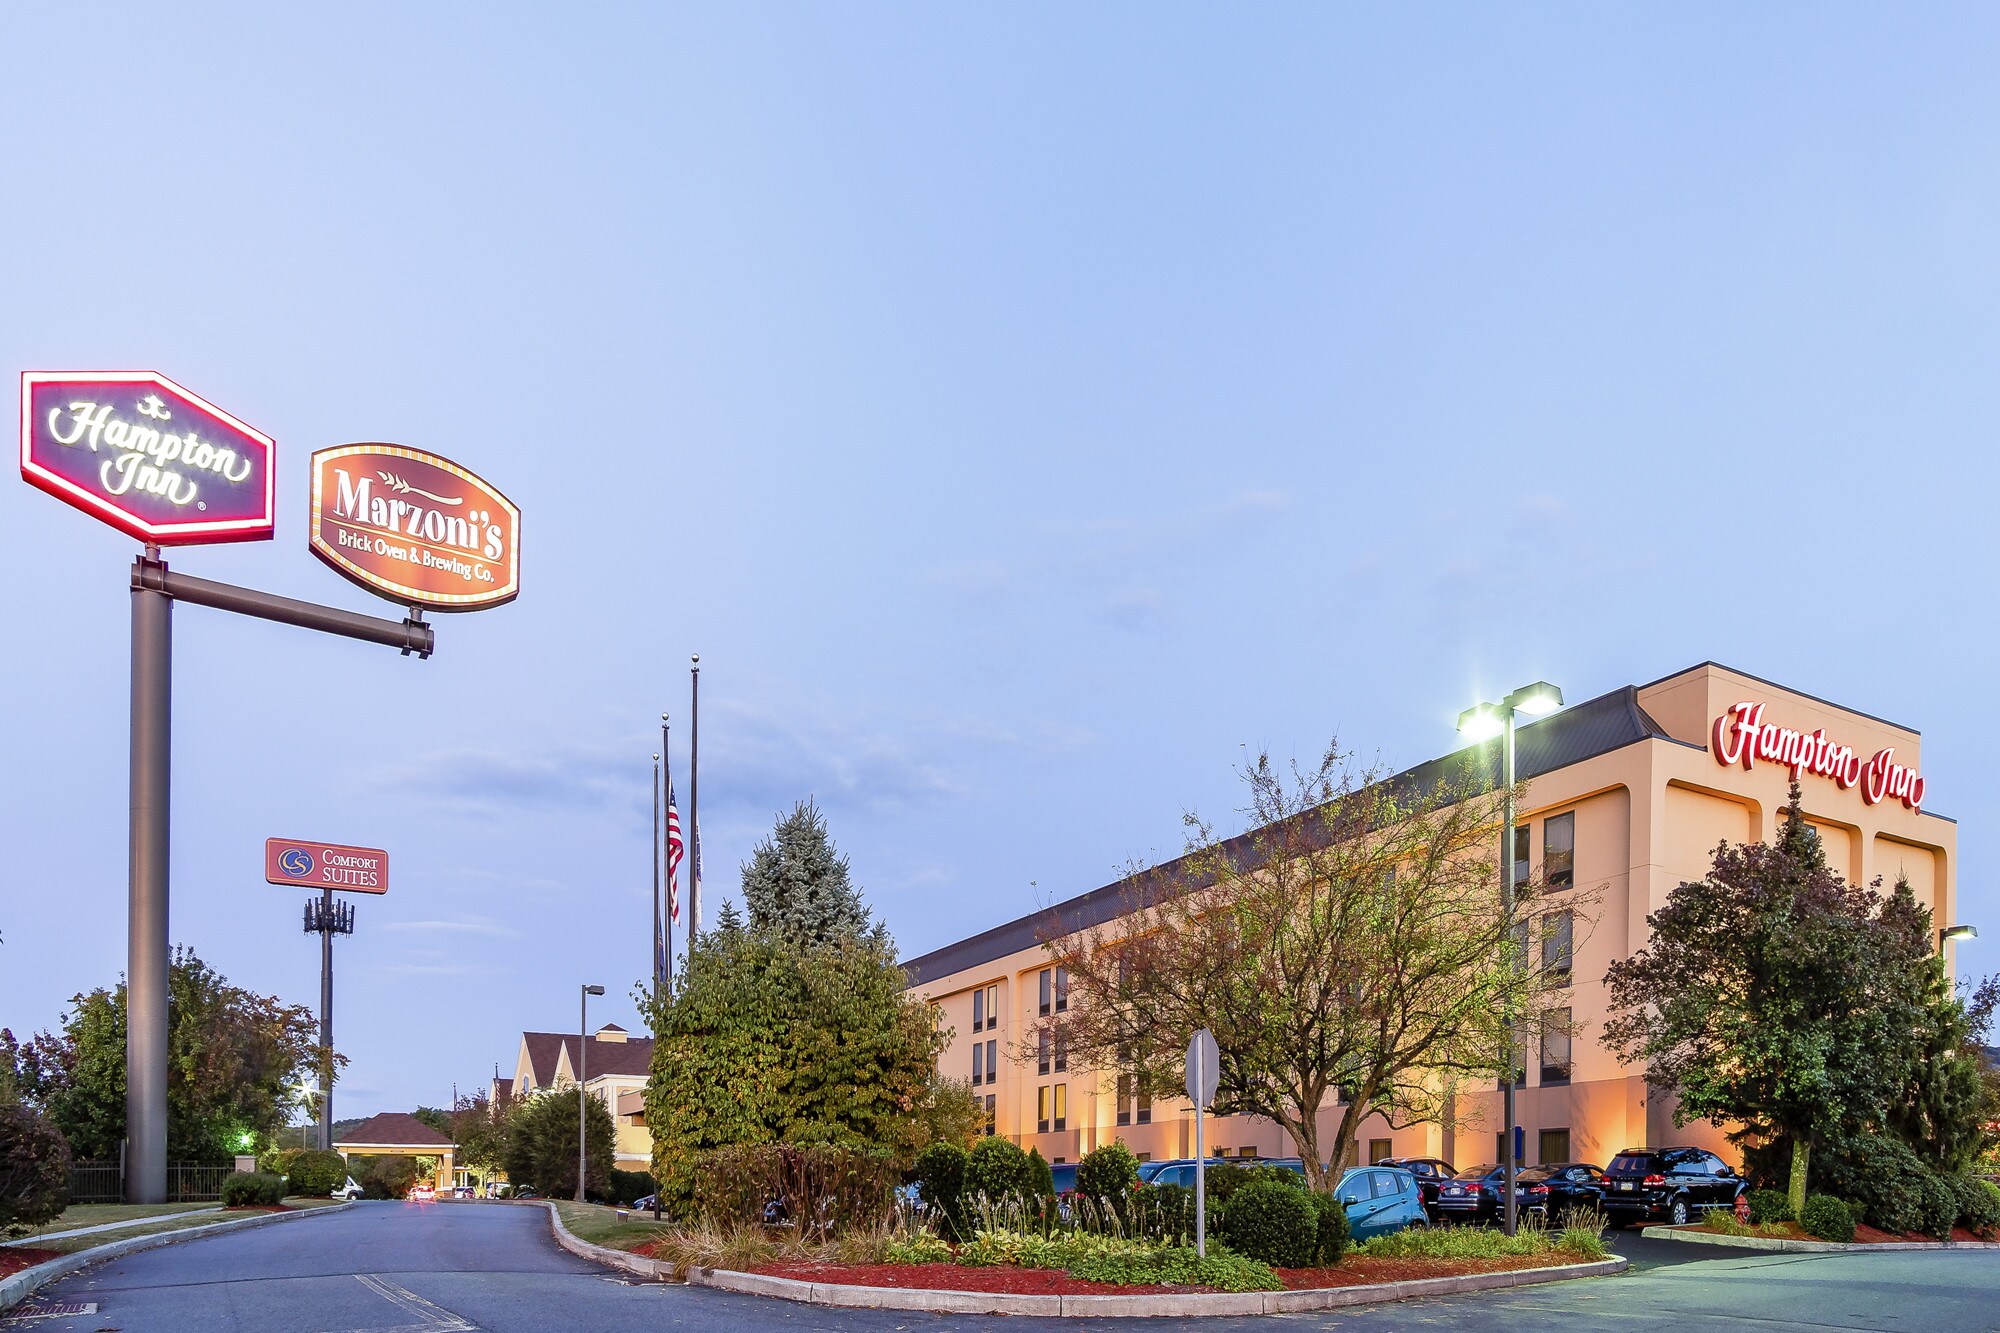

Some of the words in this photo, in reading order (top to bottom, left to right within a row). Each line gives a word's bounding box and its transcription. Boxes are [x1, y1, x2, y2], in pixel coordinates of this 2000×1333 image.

[48, 402, 251, 482] Hampton
[100, 453, 198, 505] Inn
[332, 468, 504, 562] Marzoni's
[338, 528, 373, 554] Brick
[374, 538, 408, 562] Oven
[409, 551, 422, 565] &
[422, 550, 473, 582] Brewing
[473, 562, 496, 583] Co.
[1712, 701, 1862, 790] Hampton
[1860, 747, 1926, 809] Inn
[322, 867, 378, 886] SUITES
